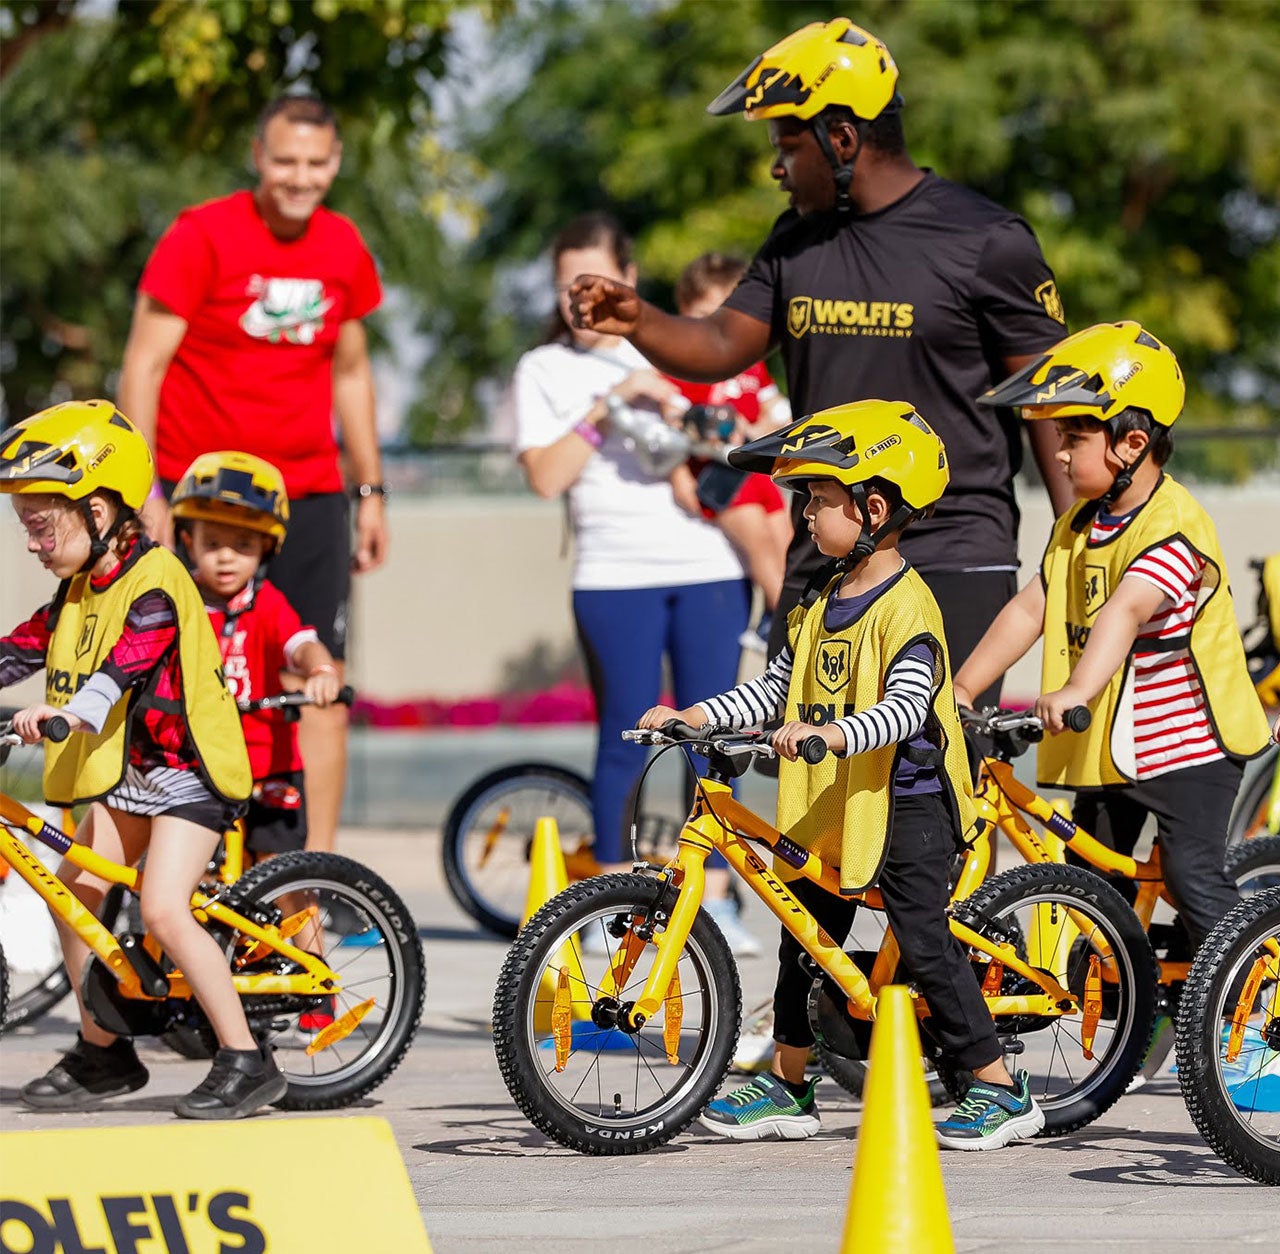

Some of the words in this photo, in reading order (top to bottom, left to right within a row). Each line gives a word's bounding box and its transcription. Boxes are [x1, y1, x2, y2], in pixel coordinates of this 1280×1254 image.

[813, 299, 914, 328] WOLFI'S
[810, 324, 858, 336] CYCLING
[861, 326, 913, 338] ACADEMY
[871, 437, 899, 457] ABUS
[12, 841, 66, 896] SCOTT
[745, 856, 806, 916] SCOTT
[1023, 884, 1098, 904] KENDA
[355, 880, 409, 944] KENDA
[584, 1120, 664, 1140] KENDA
